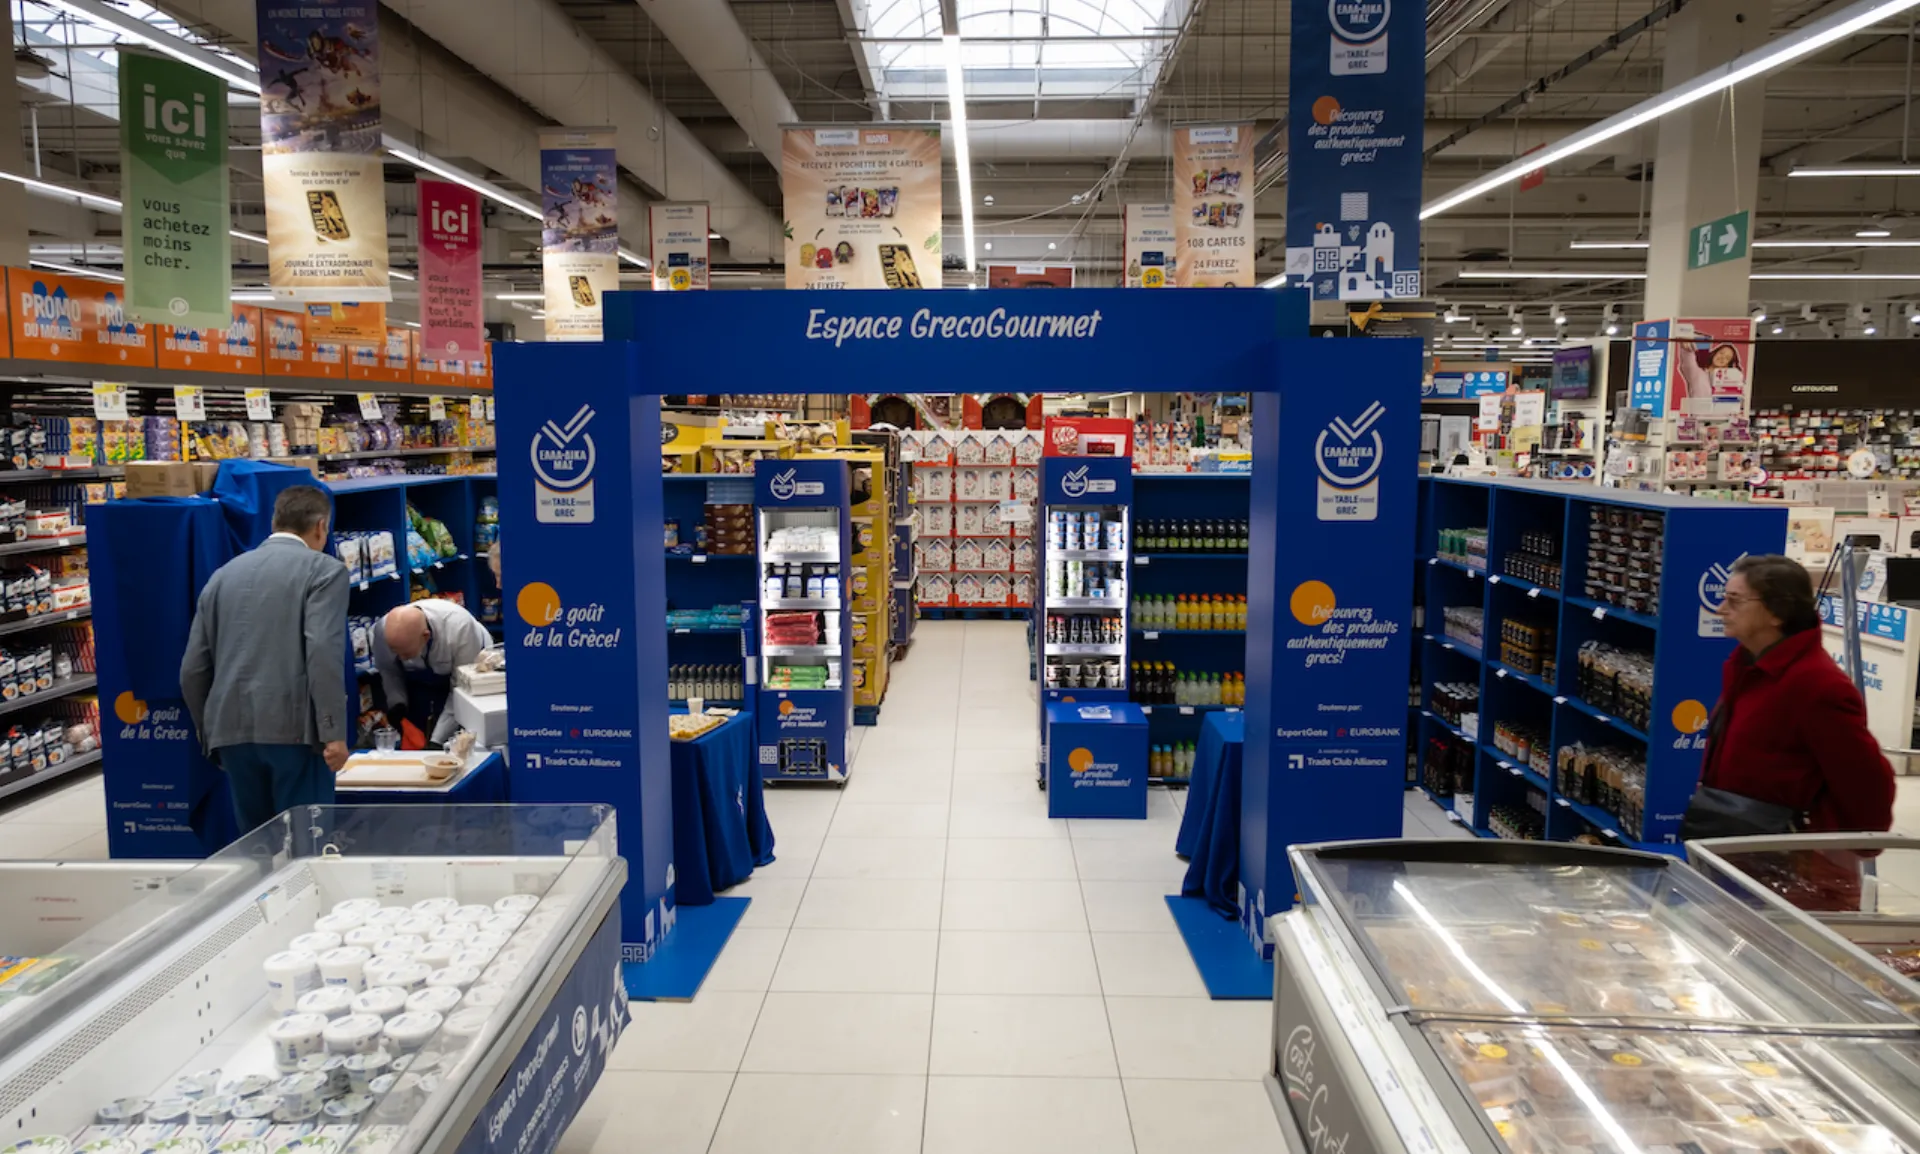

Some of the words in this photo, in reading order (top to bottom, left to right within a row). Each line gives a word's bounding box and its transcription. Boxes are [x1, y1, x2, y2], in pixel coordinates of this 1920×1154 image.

[1348, 60, 1368, 69] GREC
[143, 84, 205, 137] ici
[1330, 109, 1384, 122] Découvrez
[1308, 123, 1327, 135] des
[1329, 123, 1375, 138] produits
[145, 133, 171, 144] vous
[175, 138, 205, 150] savez
[1314, 135, 1405, 150] authentiquement
[165, 149, 186, 159] que
[1341, 150, 1376, 166] grecs!
[879, 160, 887, 168] DE
[895, 160, 924, 168] CARTES
[143, 199, 180, 214] vous
[431, 201, 468, 234] ici
[143, 217, 209, 236] achetez
[143, 234, 191, 251] moins
[1187, 238, 1204, 247] 108
[1207, 237, 1245, 246] CARTES
[144, 252, 190, 269] cher.
[284, 259, 313, 267] JOURNÉE
[1194, 261, 1204, 269] 24
[21, 292, 82, 322] PROMO
[24, 322, 39, 337] DU
[40, 323, 82, 342] MOMENT
[806, 308, 902, 348] Espace
[910, 307, 1102, 339] GrecoGourmet
[97, 331, 109, 344] DU
[109, 332, 146, 347] MOMENT
[176, 339, 208, 353] MOMENT
[1791, 385, 1838, 393] CARTOUCHES
[555, 509, 575, 517] GREC
[1336, 506, 1357, 515] GREC
[545, 603, 563, 622] Le
[566, 603, 605, 627] goût
[1312, 605, 1373, 622] Découvrez
[1322, 620, 1345, 633] des
[1346, 620, 1398, 637] produits
[523, 627, 543, 647] de
[547, 627, 563, 647] la
[568, 627, 620, 648] Grèce!
[1286, 635, 1388, 652] authentiquement
[1304, 650, 1346, 668] grecs!
[551, 704, 578, 712] Soutenu
[136, 707, 150, 721] Le
[152, 707, 181, 725] goût
[1692, 716, 1709, 730] Le
[120, 725, 135, 739] de
[138, 725, 150, 739] la
[513, 728, 562, 737] ExportGate
[583, 729, 632, 738] EUROBANK
[1277, 728, 1328, 737] ExportGate
[1350, 728, 1400, 737] EUROBANK
[1673, 734, 1691, 749] de
[1692, 734, 1706, 749] la
[544, 757, 567, 766] Trade
[568, 758, 588, 766] Club
[589, 758, 621, 767] Alliance
[1307, 757, 1331, 766] Trade
[1332, 758, 1352, 766] Club
[1353, 758, 1388, 766] Alliance
